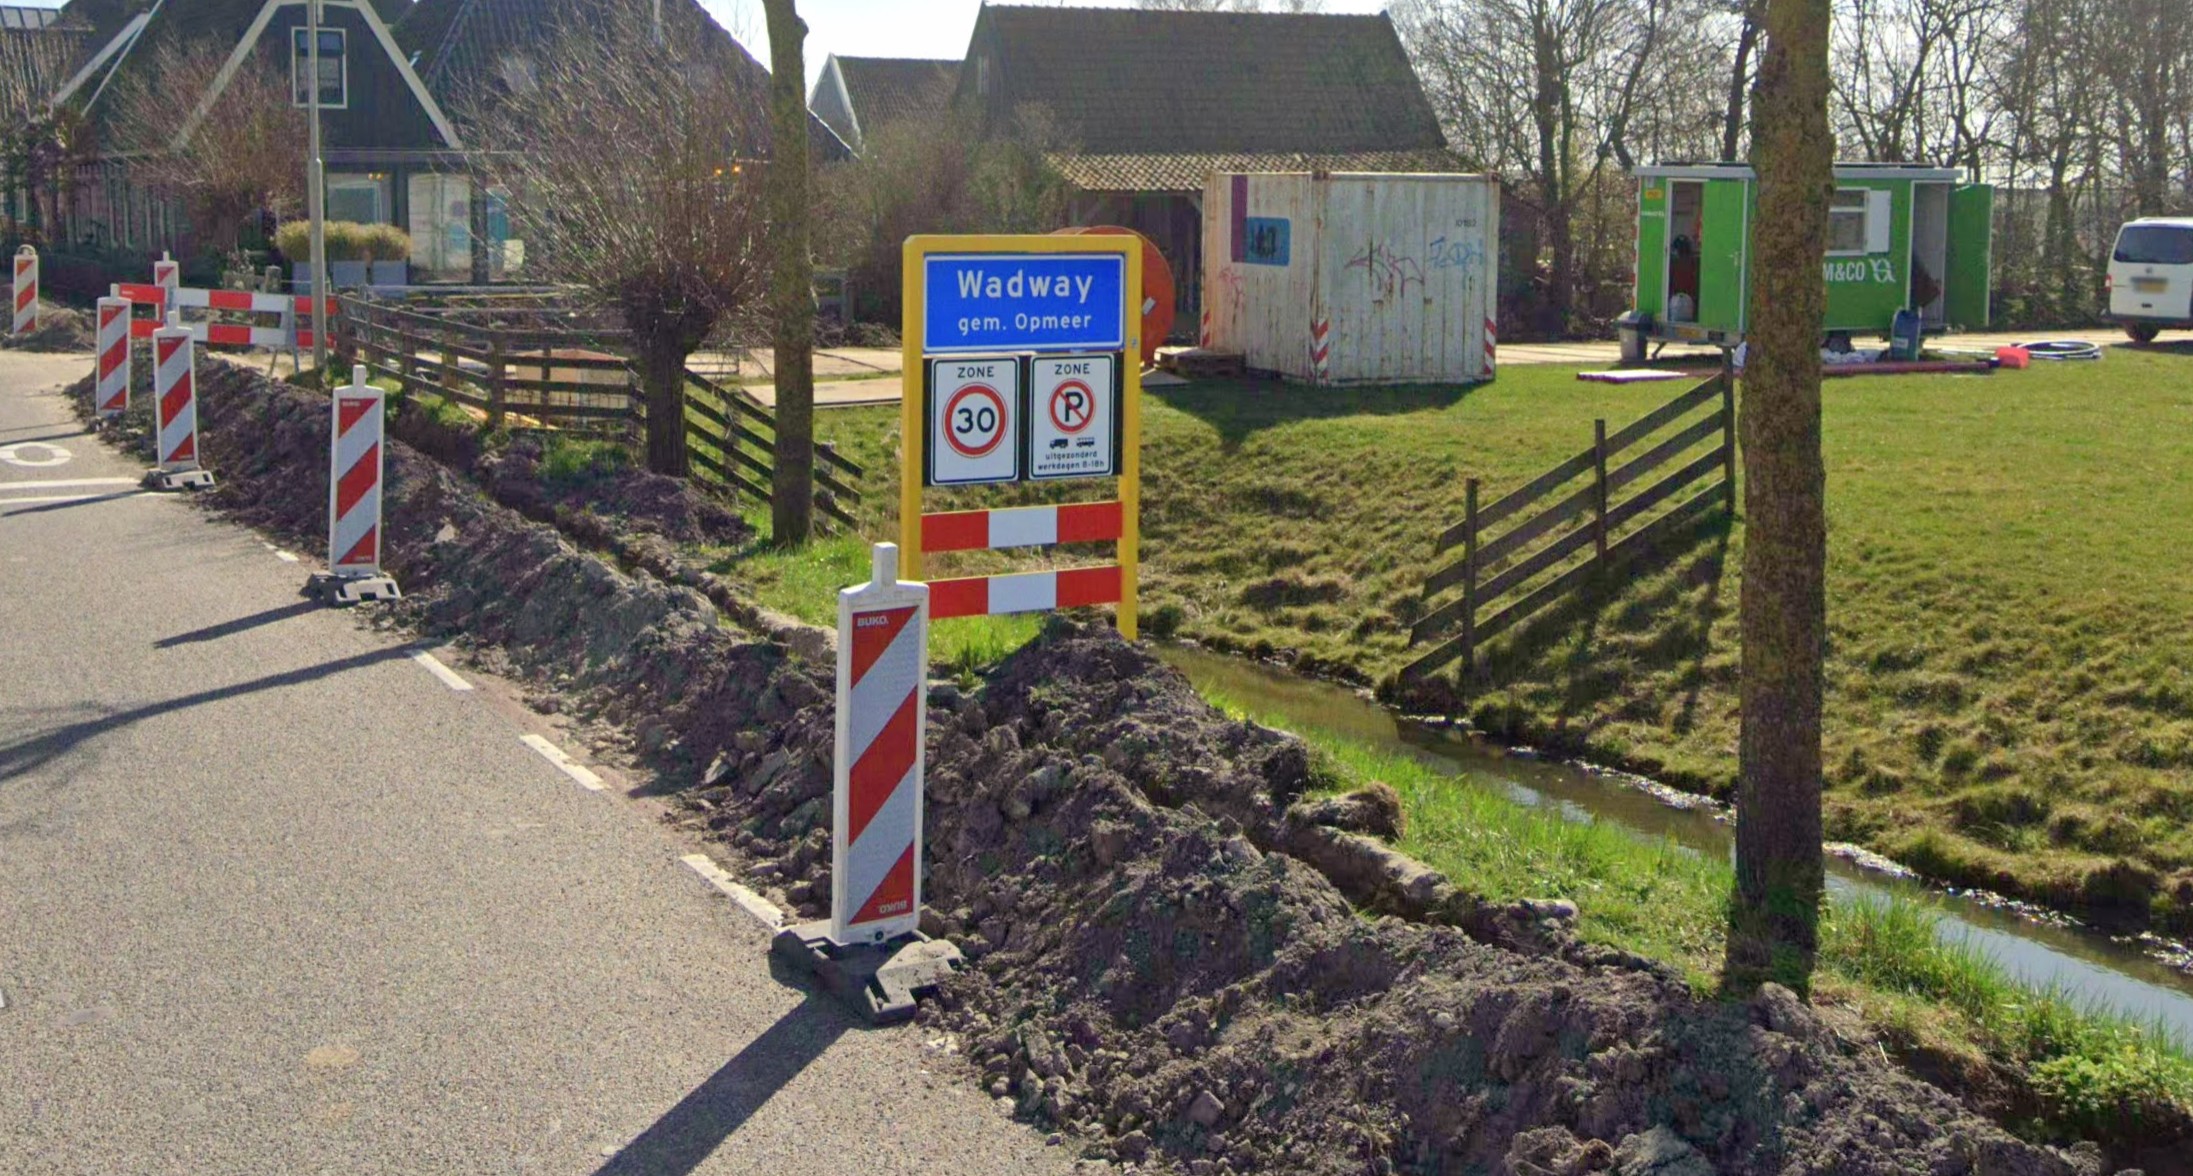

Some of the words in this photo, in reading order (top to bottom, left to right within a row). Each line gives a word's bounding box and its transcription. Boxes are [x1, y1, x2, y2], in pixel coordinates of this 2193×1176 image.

[957, 269, 1093, 304] Wadway
[958, 316, 1007, 336] gem.
[1015, 313, 1092, 332] Opmeer
[957, 366, 995, 378] ZONE
[1054, 363, 1091, 375] ZONE
[1065, 391, 1084, 422] P
[956, 407, 996, 433] 30
[1045, 451, 1097, 460] uitgezonderd
[1038, 462, 1080, 471] werkdagen
